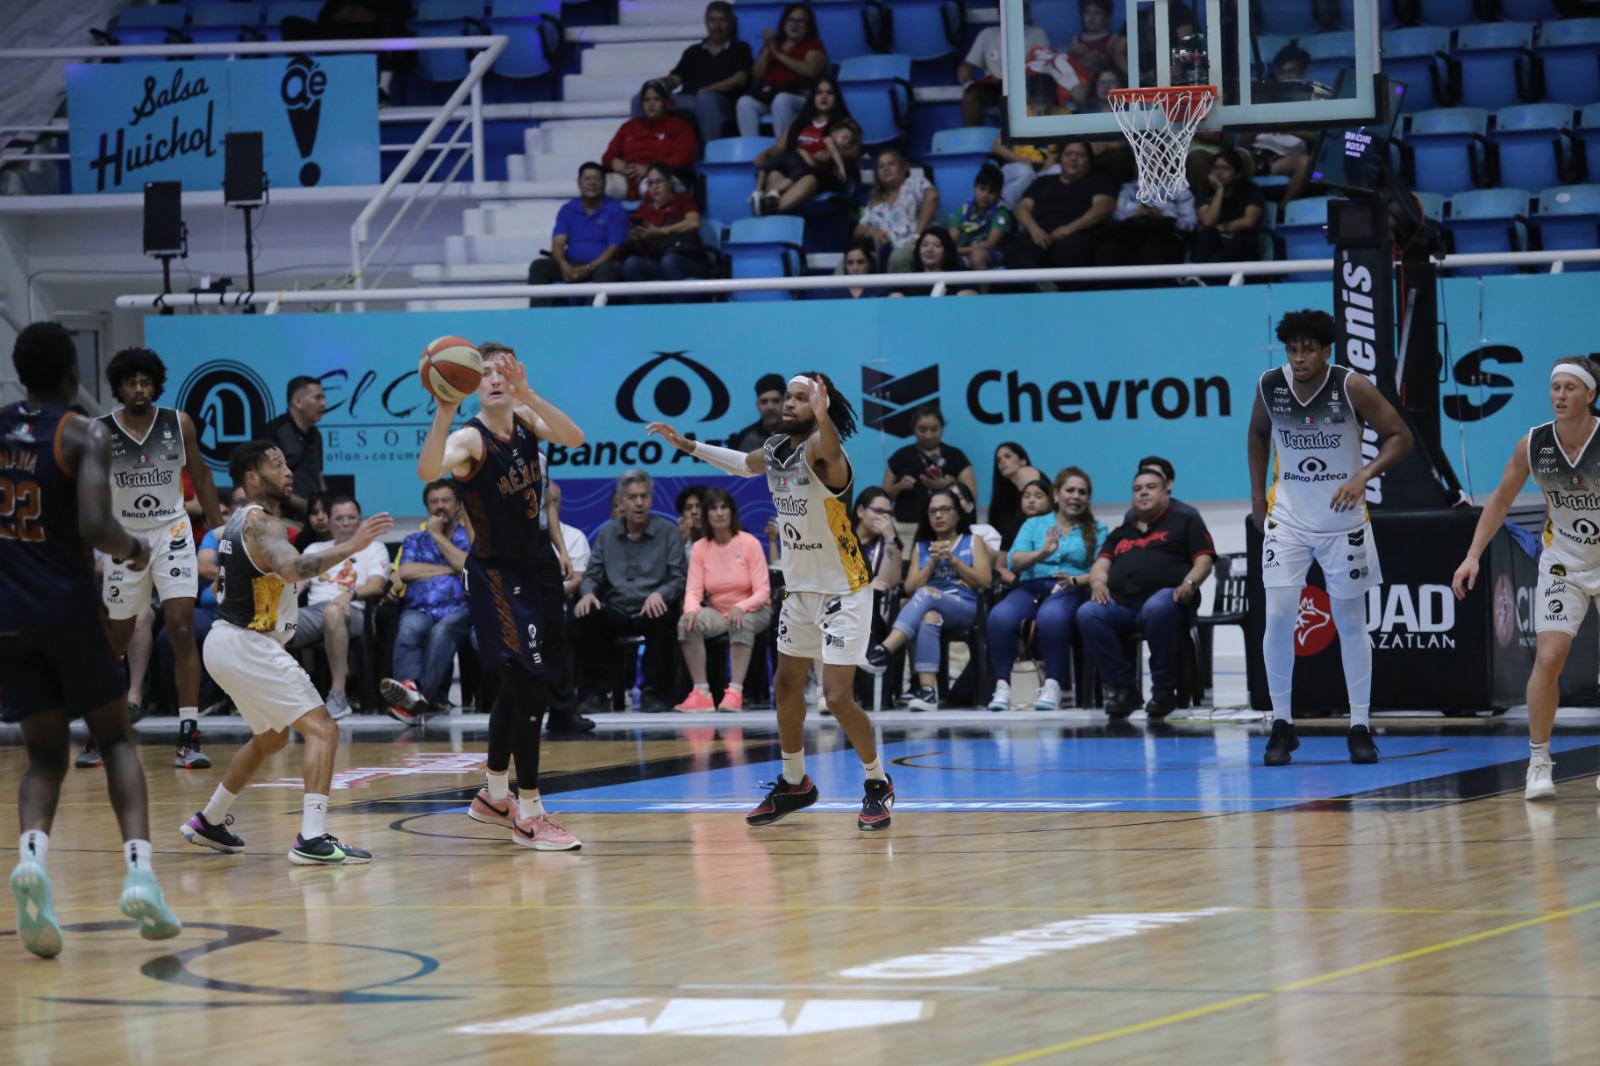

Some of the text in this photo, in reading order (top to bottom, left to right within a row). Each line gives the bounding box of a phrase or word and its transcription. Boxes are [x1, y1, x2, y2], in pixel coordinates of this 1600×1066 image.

[129, 67, 209, 126] Salsa
[90, 100, 216, 192] Huichol
[966, 369, 1232, 425] Chevron
[1279, 429, 1342, 450] Venados
[548, 439, 662, 467] Banco
[114, 468, 173, 488] Venados
[1284, 471, 1348, 483] Banco Azteca
[122, 507, 177, 519] Banco Azteca
[523, 488, 539, 519] 3
[1545, 614, 1568, 622] MEGA
[1368, 633, 1456, 649] AZATLAN
